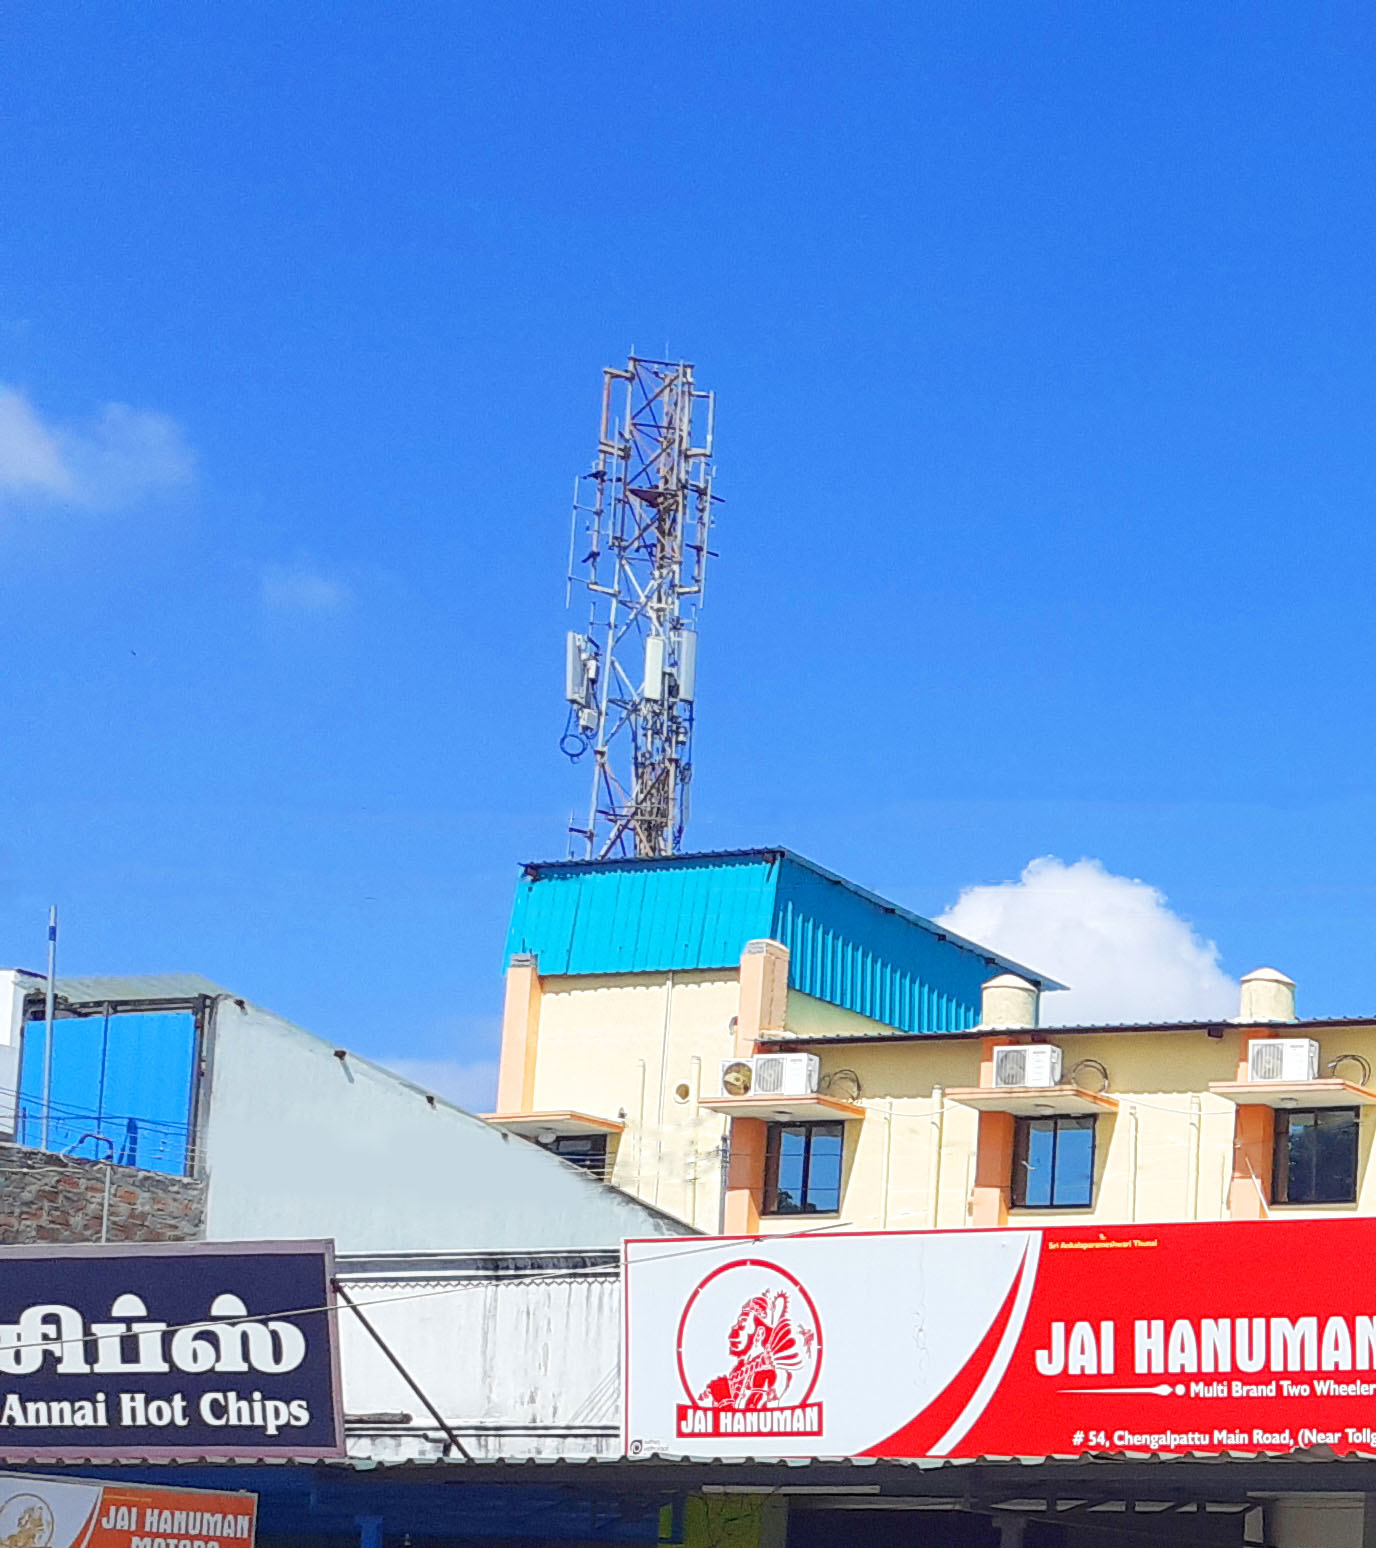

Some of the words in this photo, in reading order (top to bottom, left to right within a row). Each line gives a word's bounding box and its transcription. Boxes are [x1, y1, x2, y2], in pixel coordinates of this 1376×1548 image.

[1034, 1320, 1115, 1377] JAI
[1189, 1381, 1228, 1398] Multi
[1231, 1380, 1276, 1398] Brand
[1279, 1380, 1310, 1397] Two
[1314, 1379, 1376, 1397] Wheeler
[1, 1391, 109, 1427] Annai
[119, 1392, 189, 1427] Hot
[199, 1391, 310, 1435] Chips
[681, 1410, 714, 1434] JAI
[718, 1406, 819, 1433] HANUMAN
[1088, 1430, 1111, 1448] 54,
[1113, 1430, 1210, 1449] Chengalpattu
[1213, 1429, 1249, 1445] Main
[1252, 1429, 1294, 1447] Road,
[1297, 1428, 1342, 1447] (Near
[101, 1505, 138, 1532] JAI
[144, 1508, 250, 1539] HANUMAN
